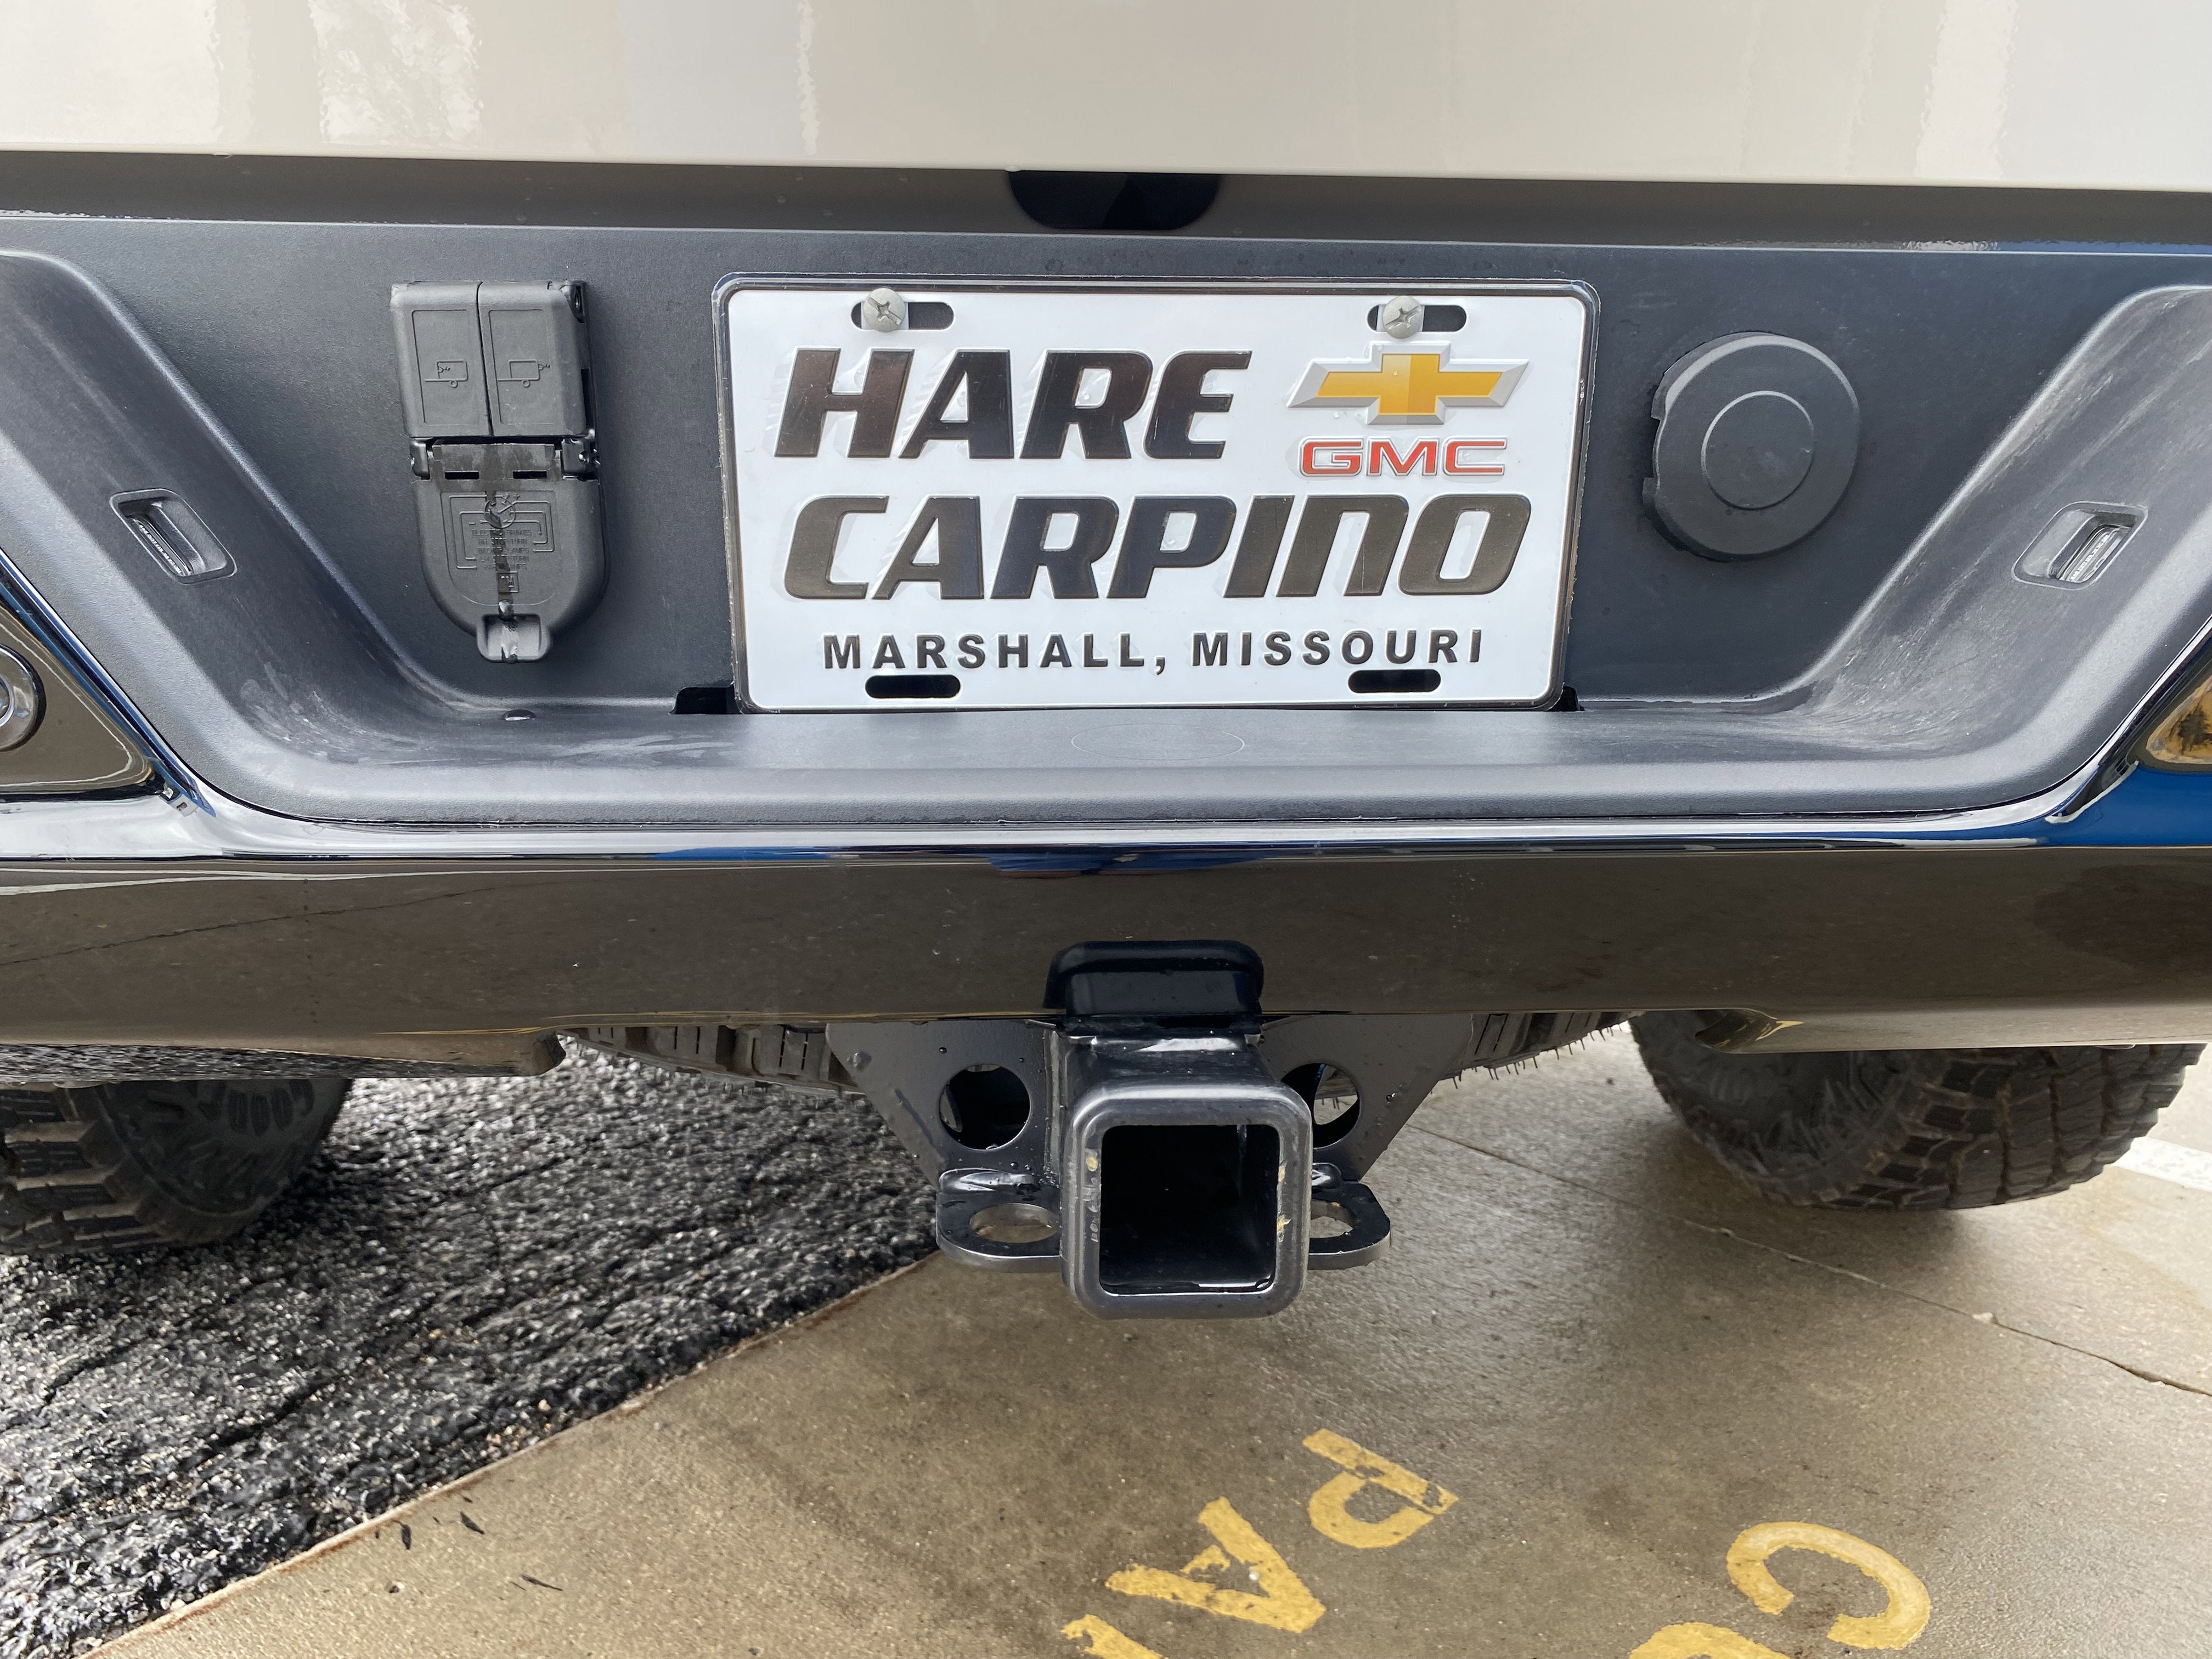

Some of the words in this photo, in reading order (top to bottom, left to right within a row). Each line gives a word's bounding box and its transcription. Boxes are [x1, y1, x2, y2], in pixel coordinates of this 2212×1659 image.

[773, 347, 1252, 460] HARE
[1298, 435, 1508, 477] GMC
[783, 493, 1533, 600] CARPINO
[823, 633, 1166, 676] MARSHALL,
[1191, 628, 1482, 669] MISSOURI
